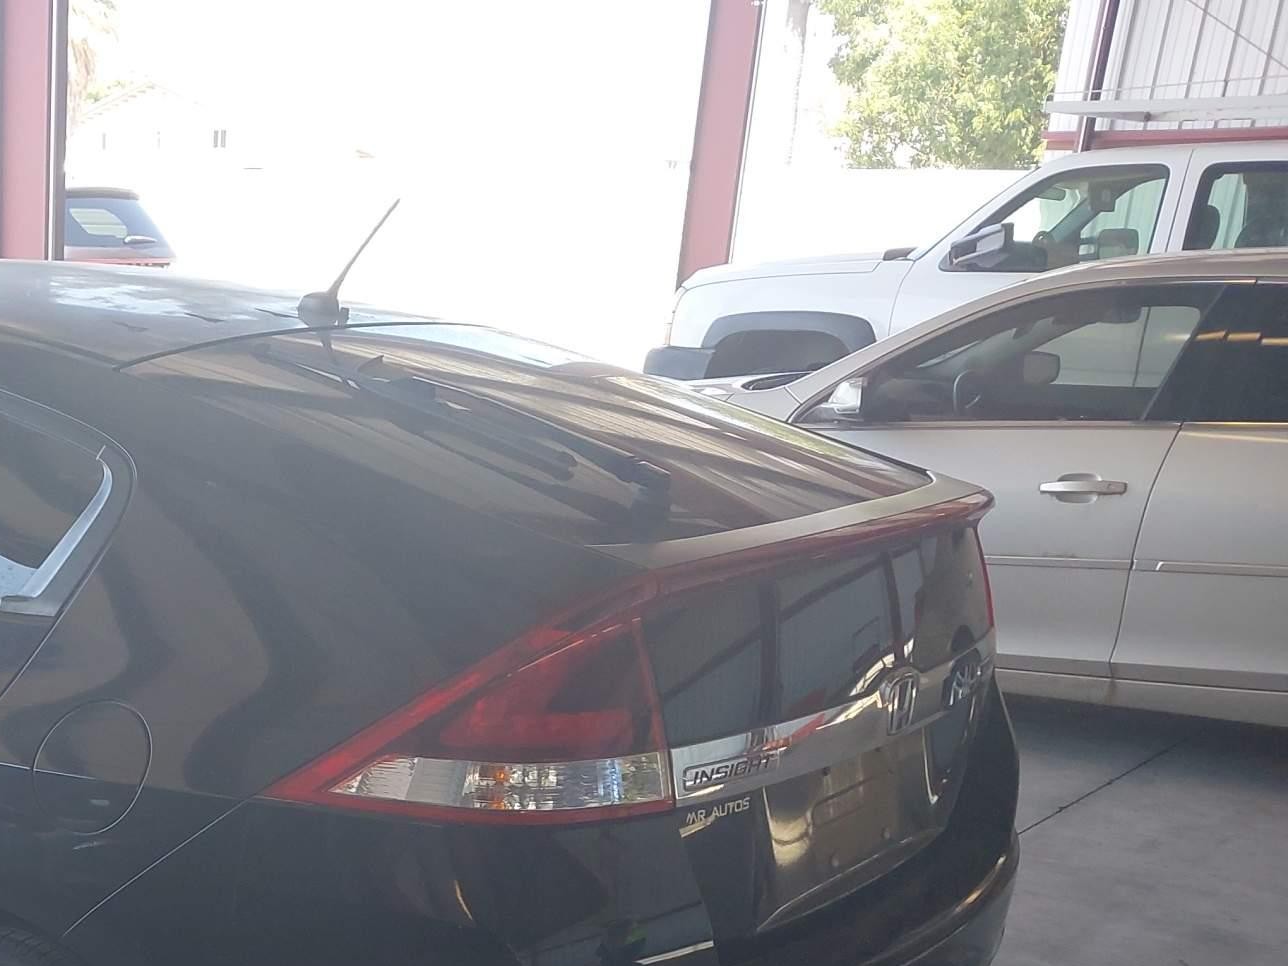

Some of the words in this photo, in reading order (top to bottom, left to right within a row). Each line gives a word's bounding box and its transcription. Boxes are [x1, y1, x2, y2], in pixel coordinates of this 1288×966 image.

[692, 753, 776, 785] INSIGHT
[686, 809, 706, 824] MR
[712, 797, 751, 817] AUTOS
